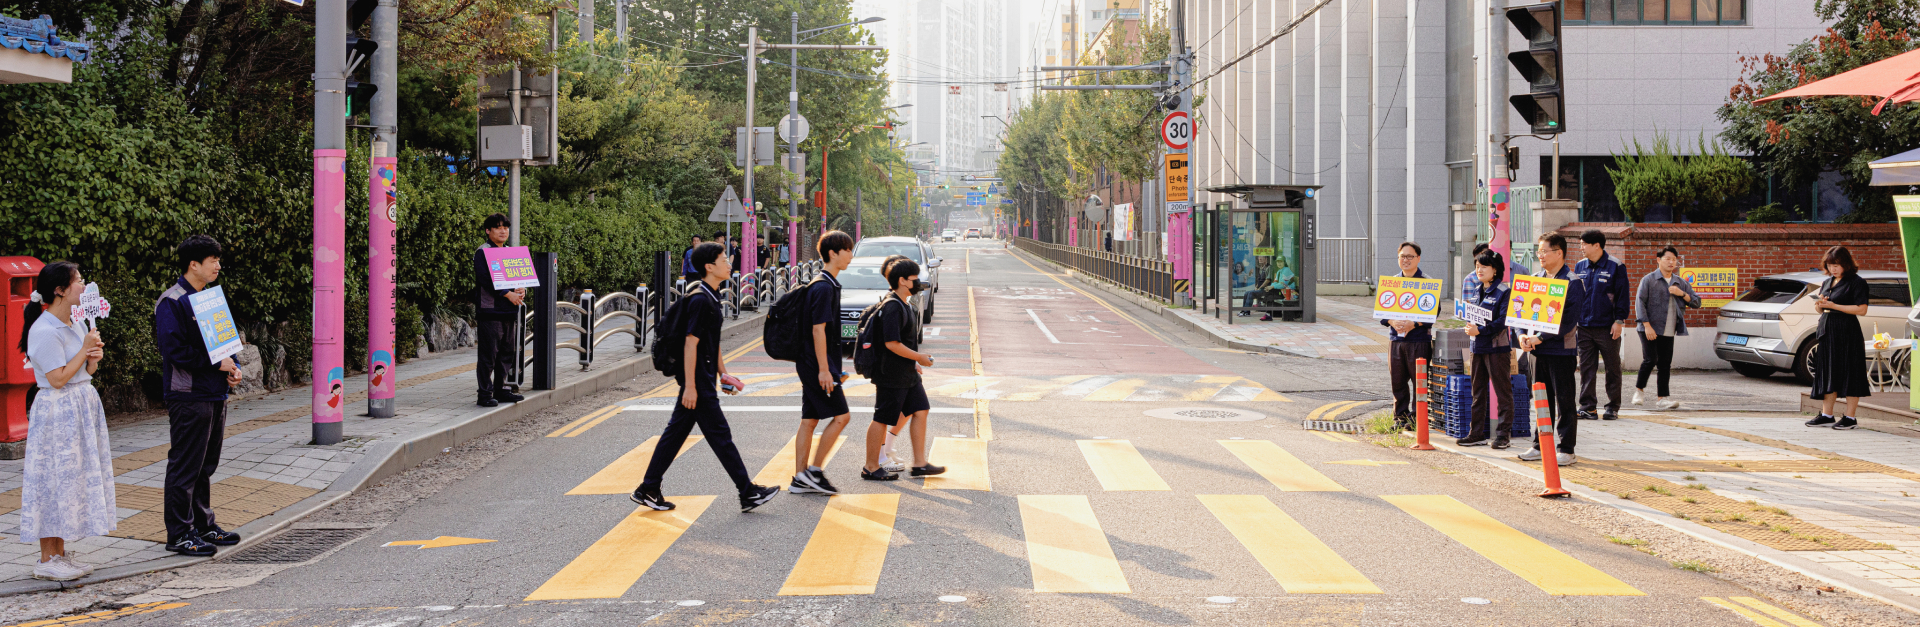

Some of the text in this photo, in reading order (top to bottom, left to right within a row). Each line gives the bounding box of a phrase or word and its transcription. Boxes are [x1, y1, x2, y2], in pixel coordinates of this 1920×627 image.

[1170, 122, 1188, 139] 30
[502, 259, 524, 268] 횡단보도
[506, 266, 534, 278] 일시 정지
[1719, 273, 1726, 282] 투기
[1381, 280, 1439, 290] 차조심! 좌우를 살펴요
[1516, 281, 1529, 290] 멈추고
[1550, 286, 1564, 294] 건너요
[1466, 306, 1492, 318] HYUNDAI
[1466, 313, 1485, 324] STEEL
